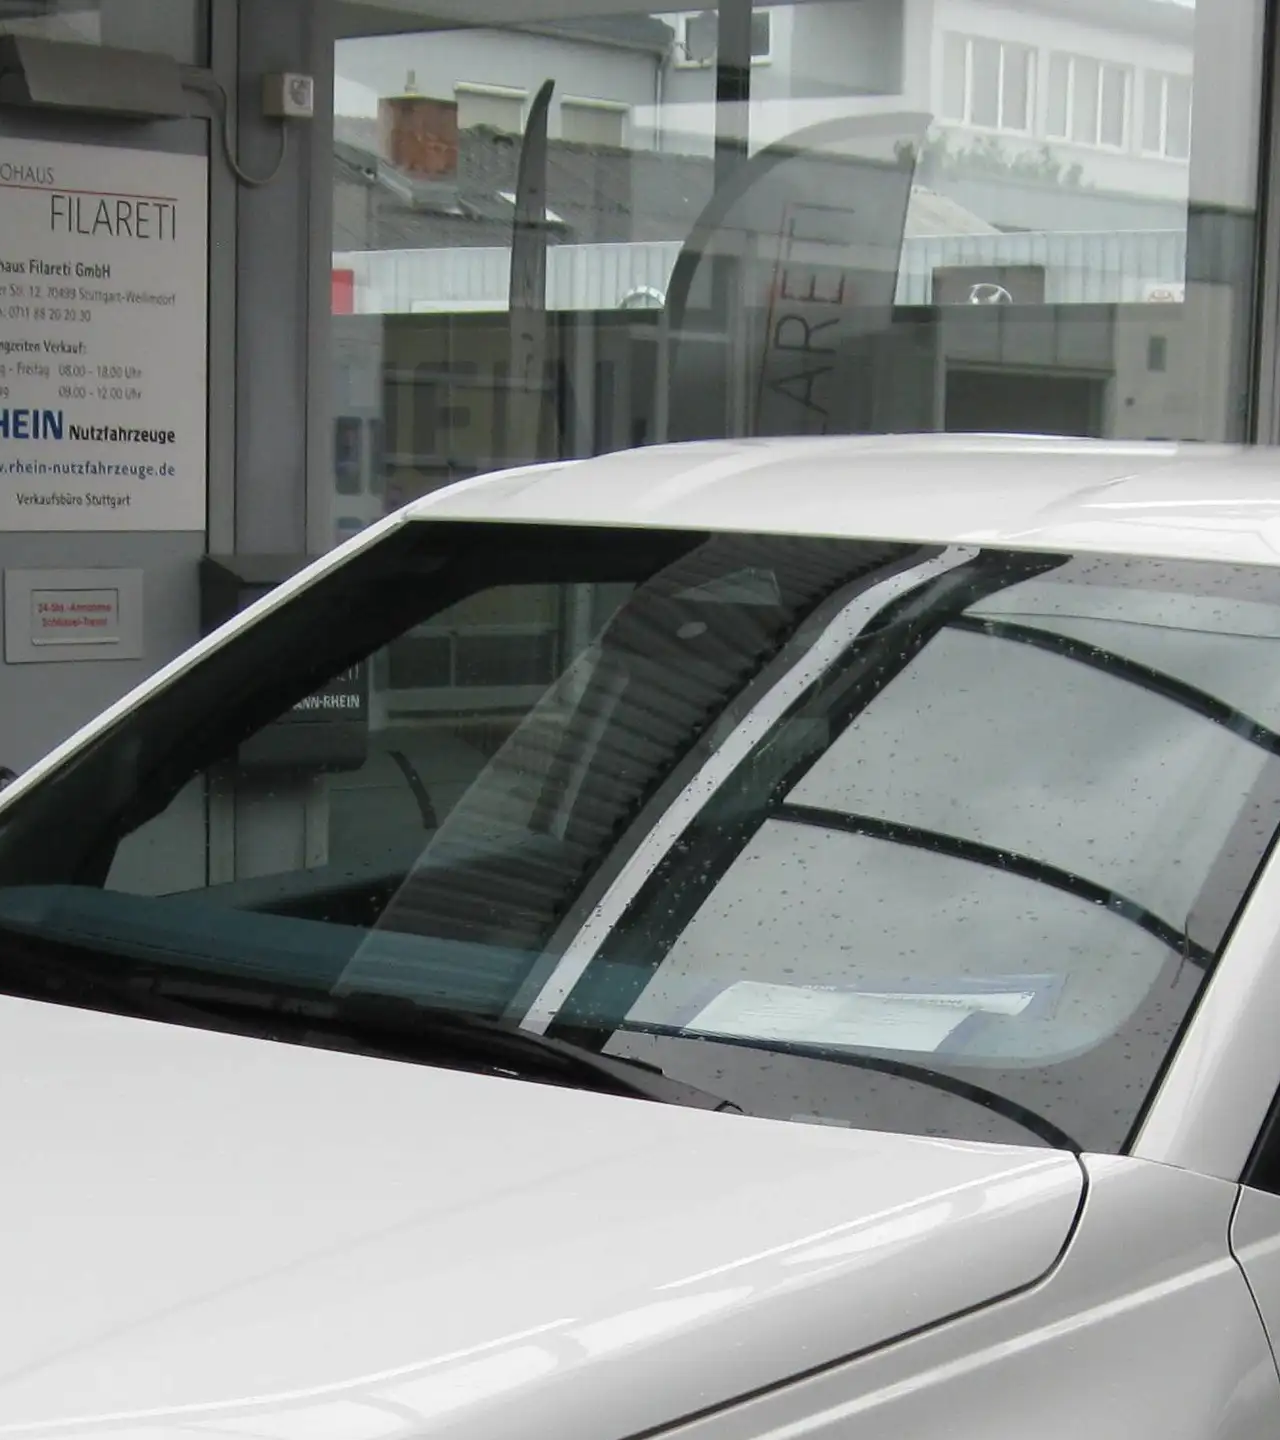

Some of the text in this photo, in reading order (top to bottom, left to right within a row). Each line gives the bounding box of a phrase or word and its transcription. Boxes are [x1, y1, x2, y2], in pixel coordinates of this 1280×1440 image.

[50, 194, 177, 241] FILARETI
[29, 259, 71, 277] Filareti
[75, 262, 111, 279] GmbH
[69, 425, 177, 444] Nutzfahrzeuge
[16, 492, 131, 509] Verkaufsbüro Stuttgart
